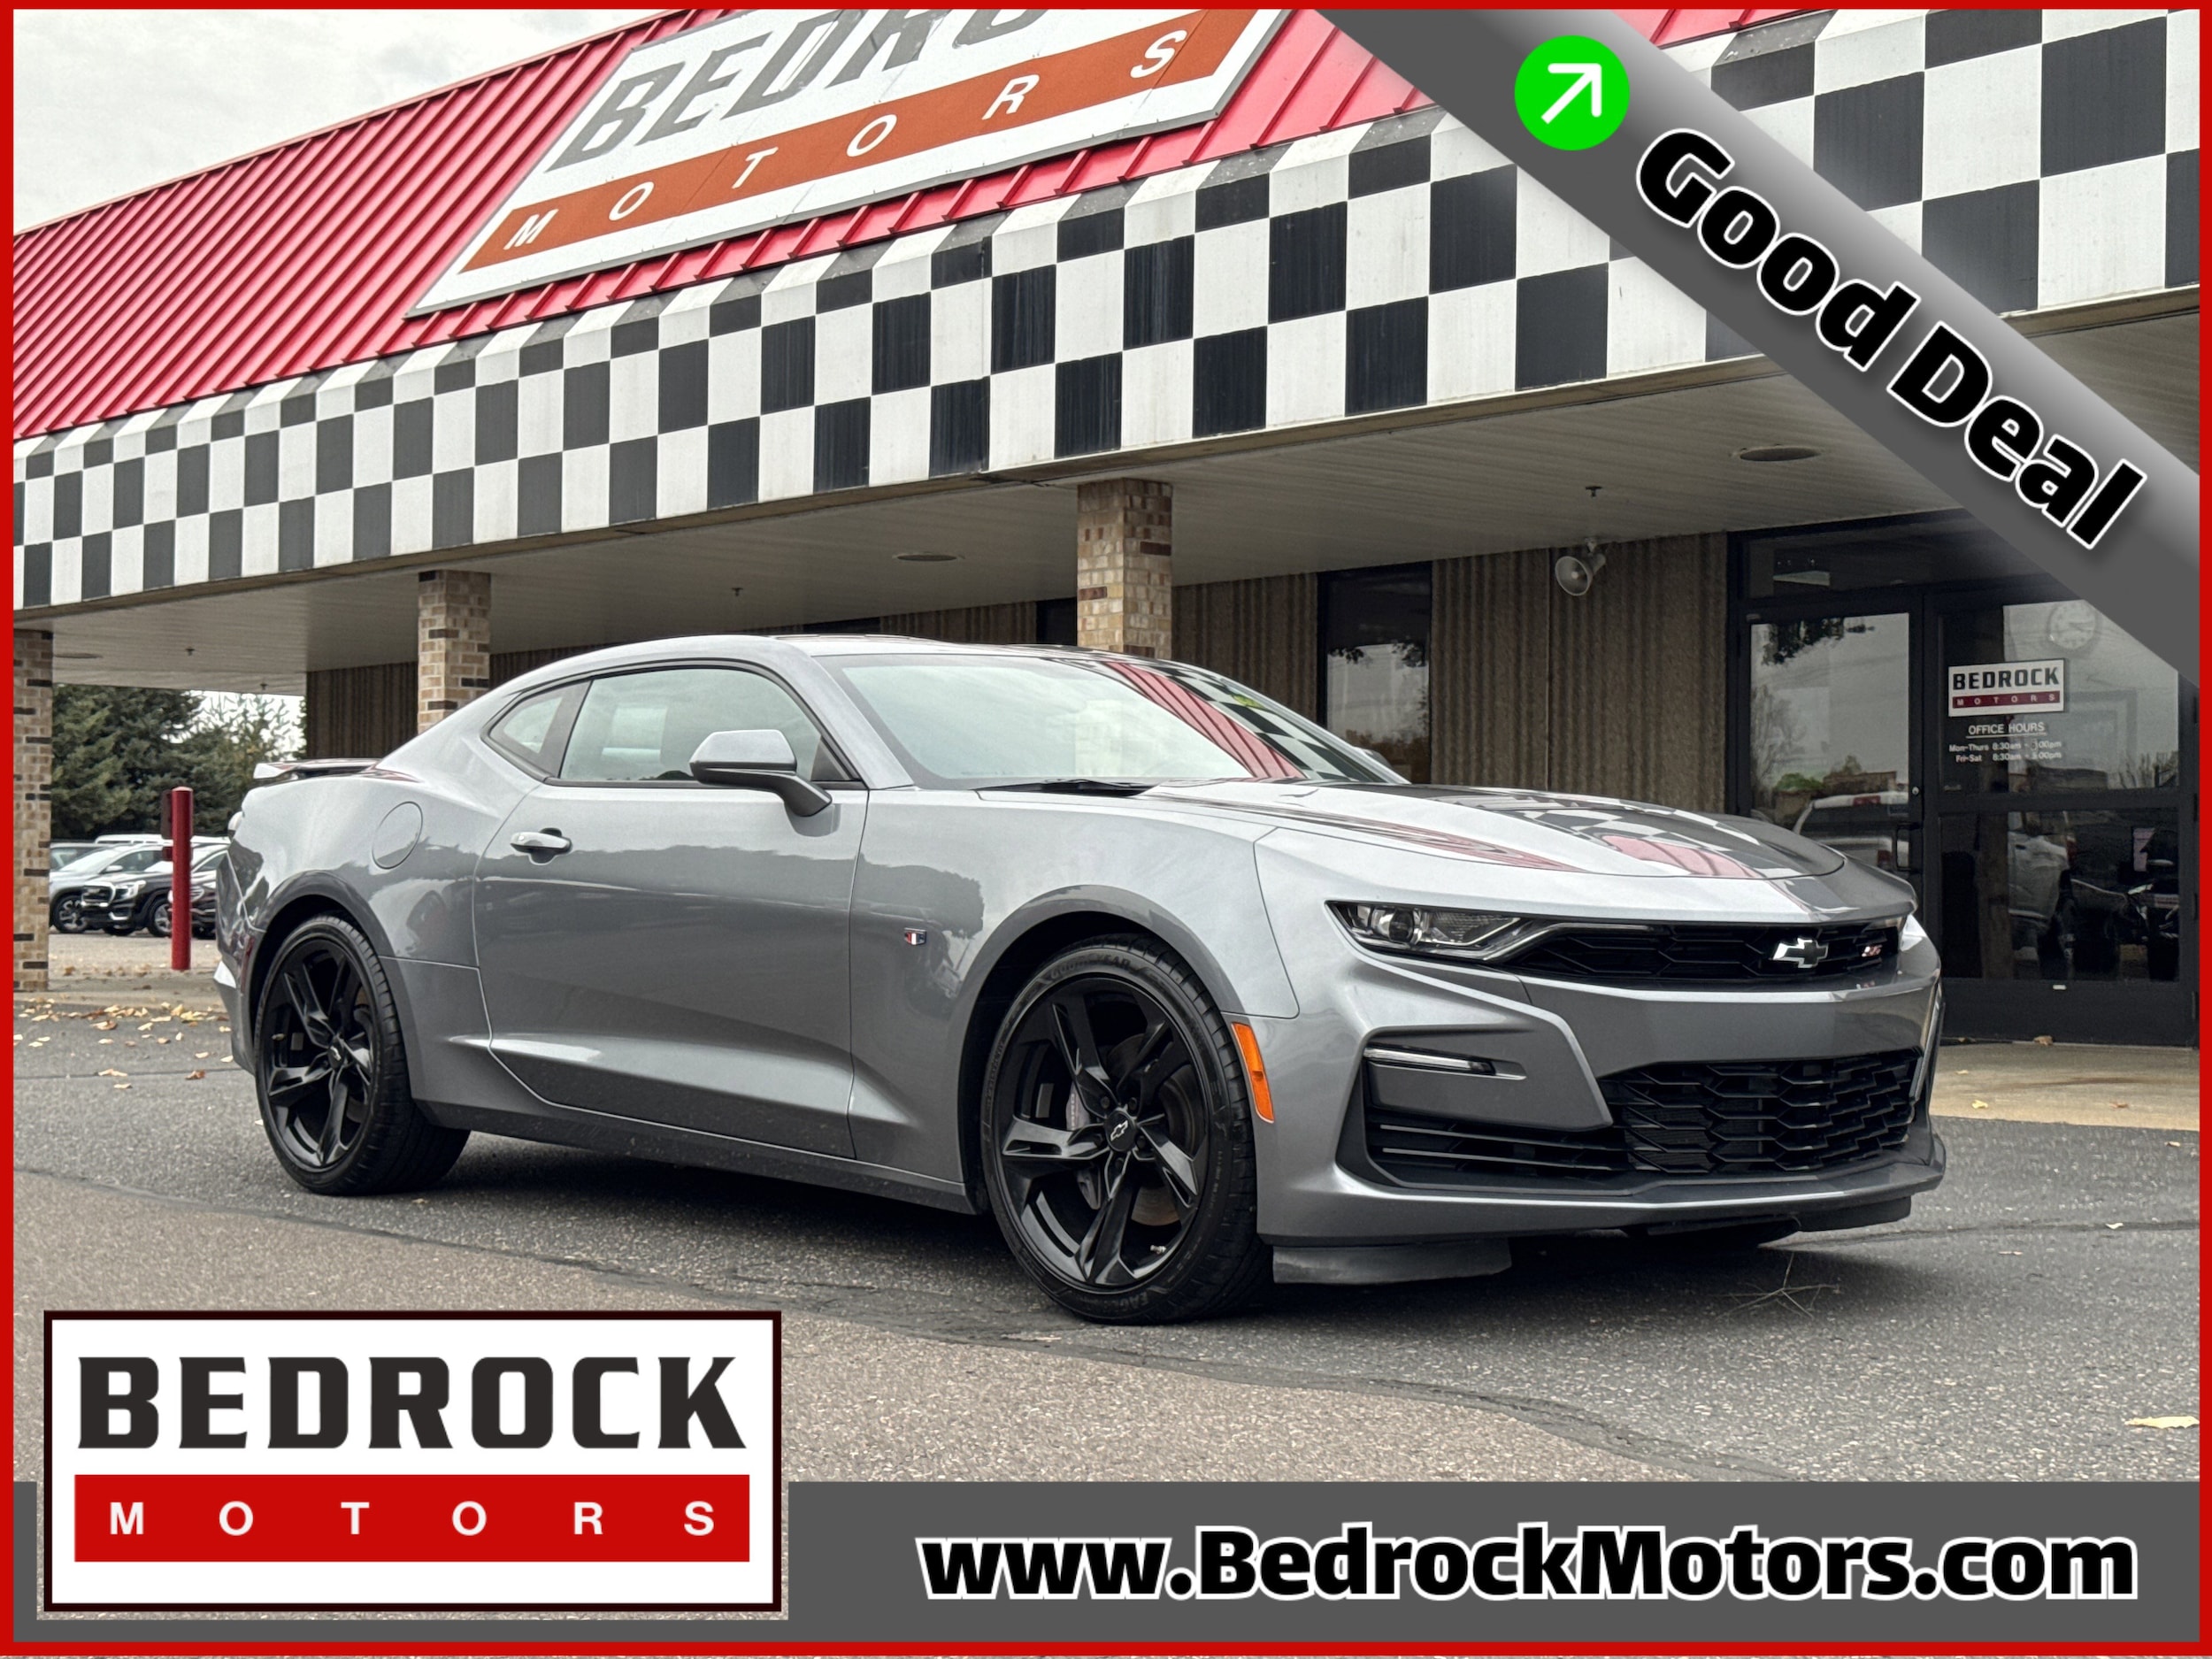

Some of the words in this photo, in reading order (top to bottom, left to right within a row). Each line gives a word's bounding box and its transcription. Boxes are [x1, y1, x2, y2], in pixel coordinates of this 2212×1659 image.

[503, 29, 1188, 250] MOTORS
[1953, 667, 2060, 690] BEDROCK
[1956, 693, 2055, 706] MOTORS
[1968, 724, 2004, 735] OFFICE
[2008, 722, 2045, 733] HOURS
